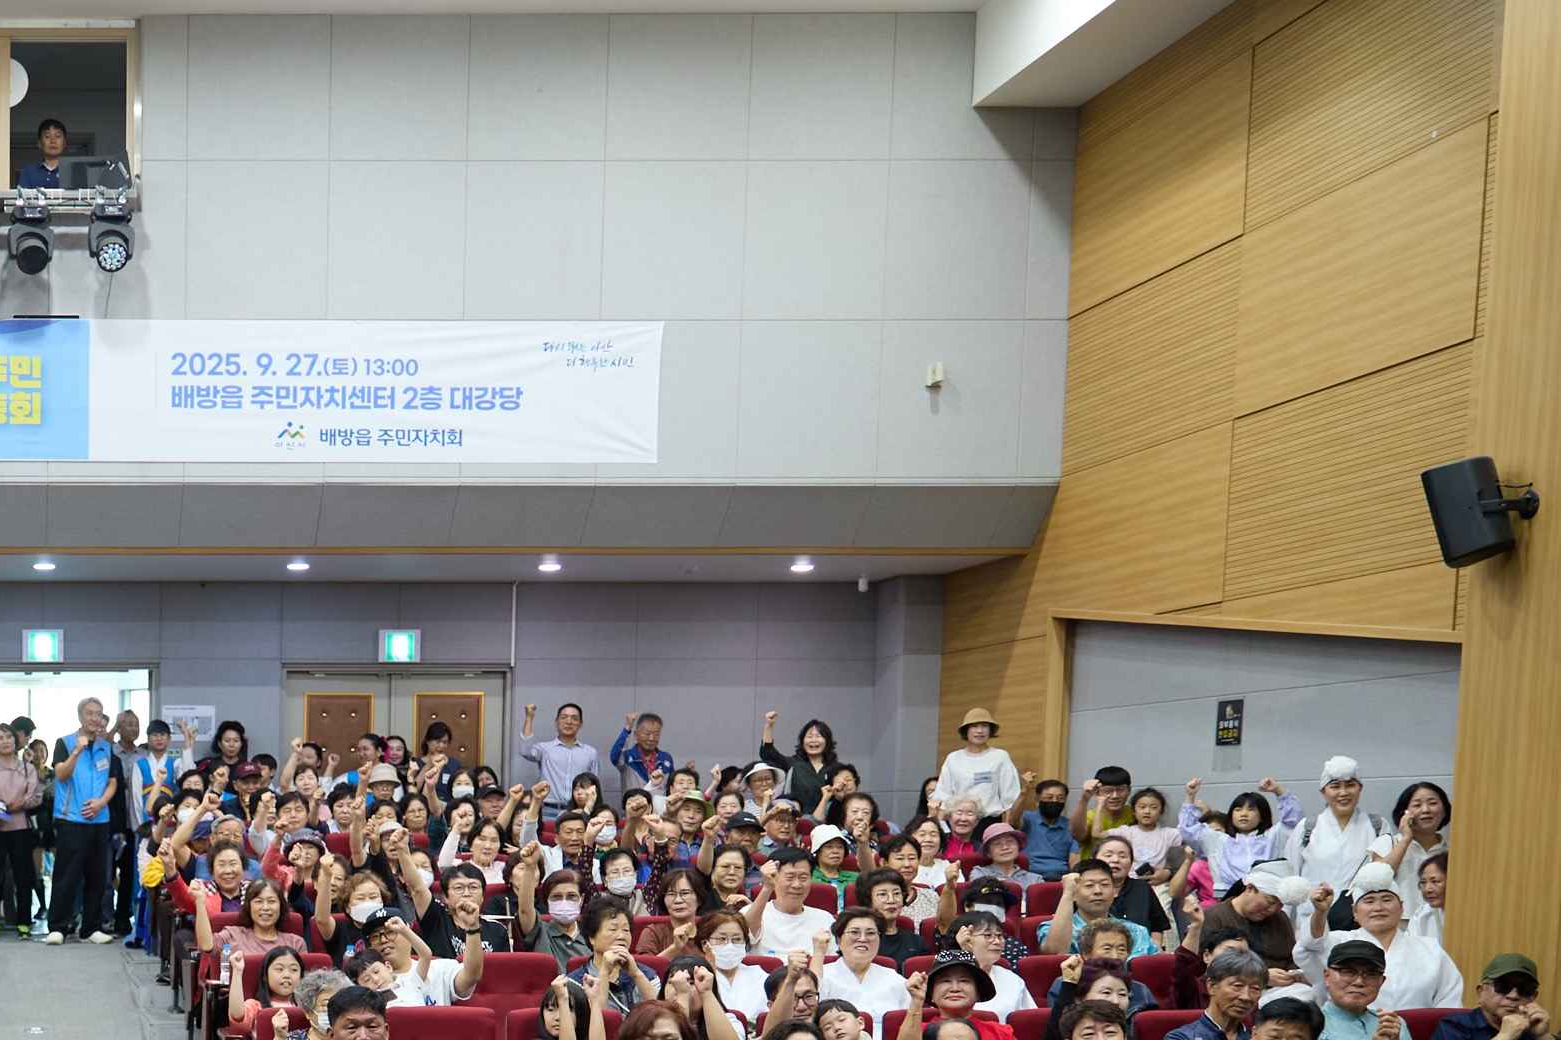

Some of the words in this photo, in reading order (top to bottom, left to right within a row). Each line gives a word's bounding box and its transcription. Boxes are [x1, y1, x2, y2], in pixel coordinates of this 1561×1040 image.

[170, 352, 248, 377] 2025.
[255, 352, 278, 377] 9.
[285, 351, 358, 378] 27.(토)
[364, 358, 419, 377] 13:00
[170, 384, 245, 410] 배방읍
[250, 385, 397, 411] 주민자치센터
[402, 385, 443, 411] 2층
[449, 386, 524, 411] 대강당
[319, 428, 373, 447] 배방읍
[376, 428, 464, 448] 주민자치회
